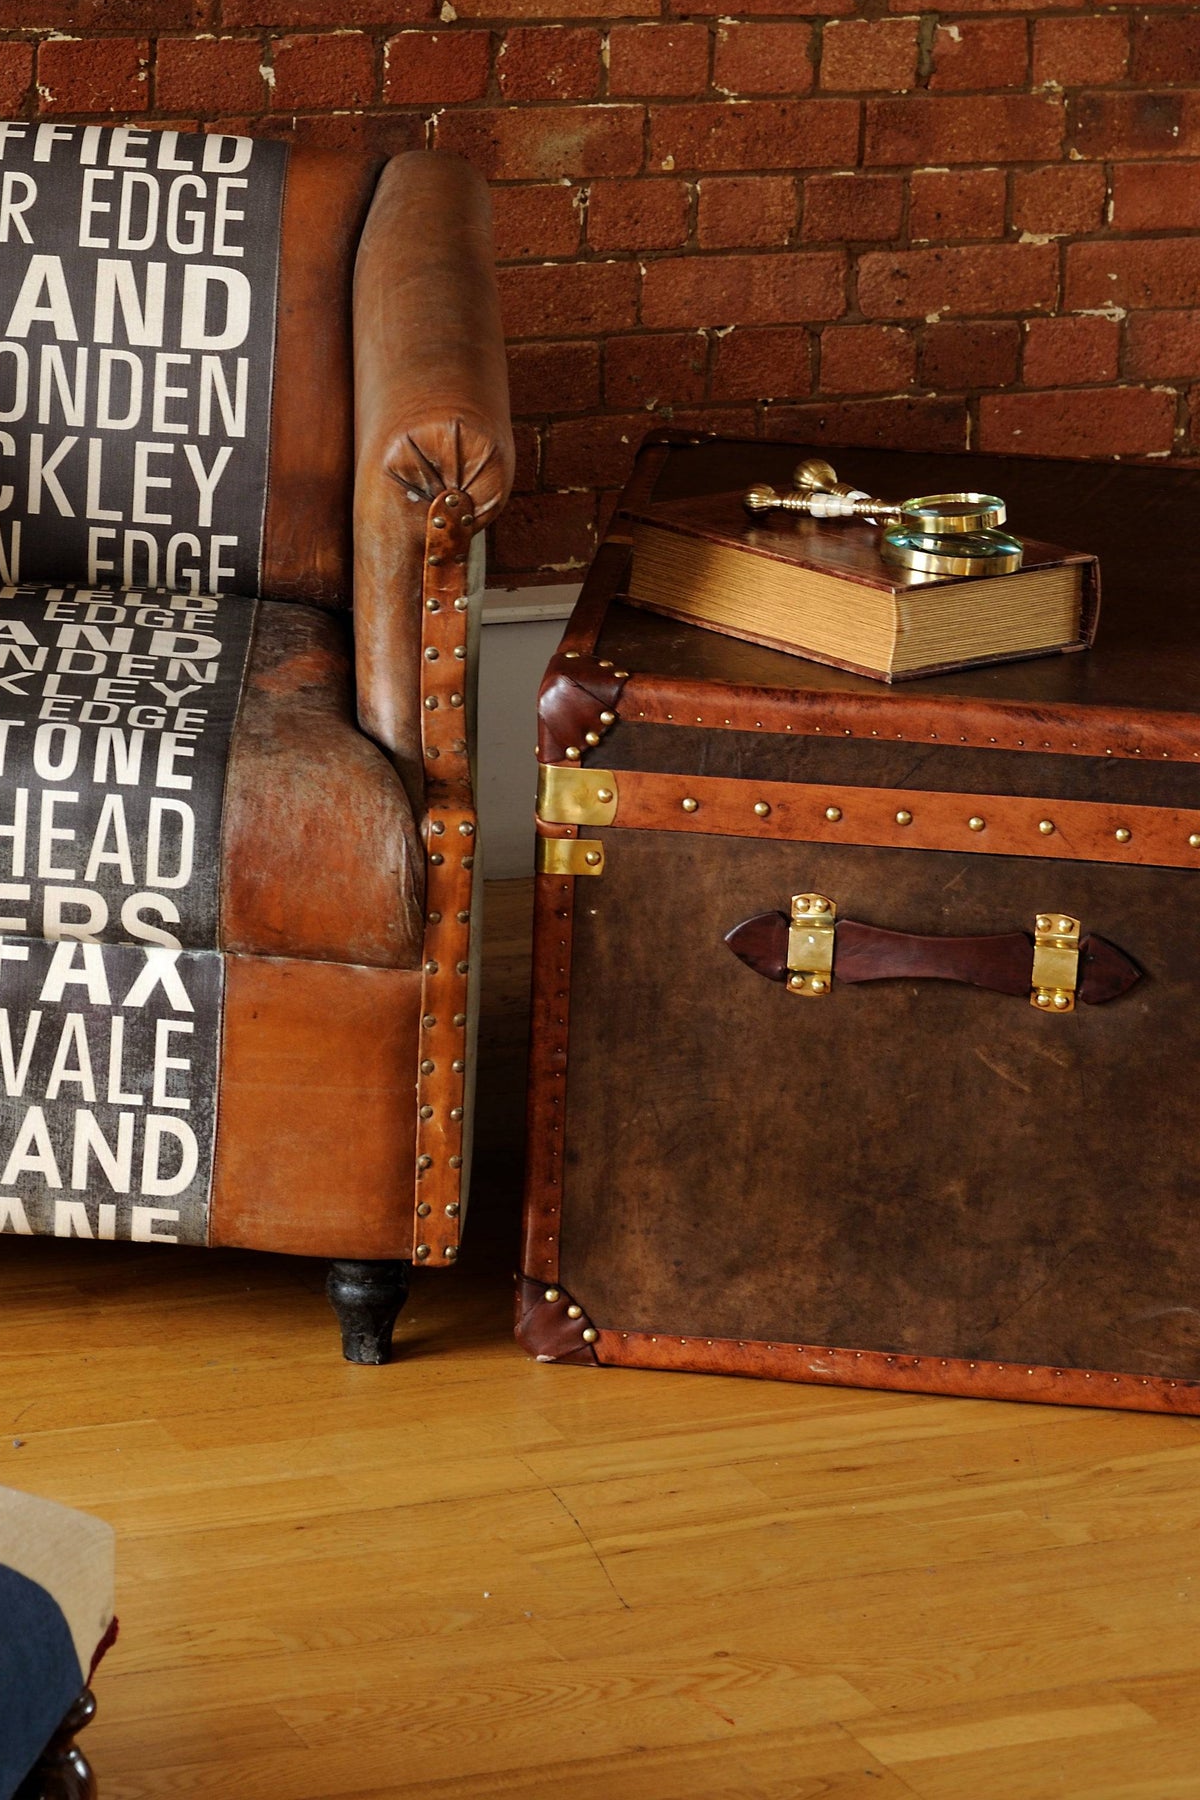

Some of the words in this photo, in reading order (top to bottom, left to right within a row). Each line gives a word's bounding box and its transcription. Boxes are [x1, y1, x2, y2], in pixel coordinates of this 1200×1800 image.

[78, 168, 248, 257] EDGE
[43, 600, 217, 633] EDGE
[38, 697, 209, 733] EDGE
